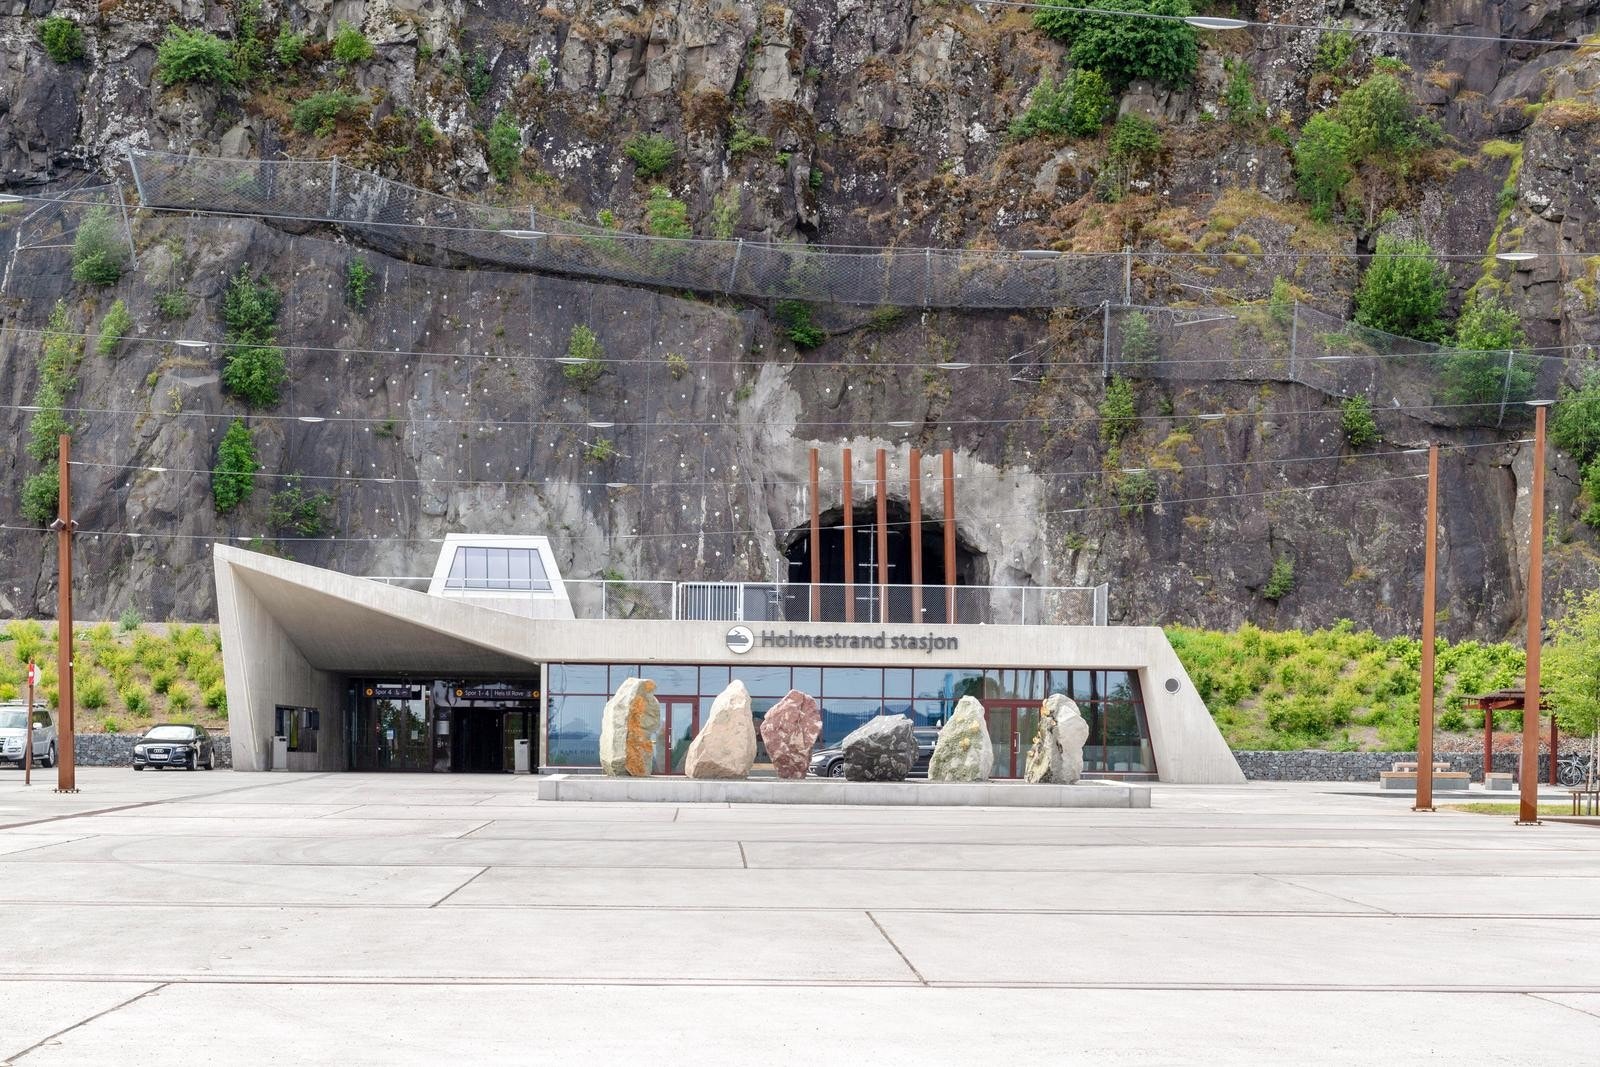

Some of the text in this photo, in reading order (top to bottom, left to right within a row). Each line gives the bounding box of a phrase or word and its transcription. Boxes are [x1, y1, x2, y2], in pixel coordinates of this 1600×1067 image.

[761, 630, 959, 654] Holmestrand stasjon
[375, 689, 387, 697] Spor
[465, 689, 477, 697] Spor
